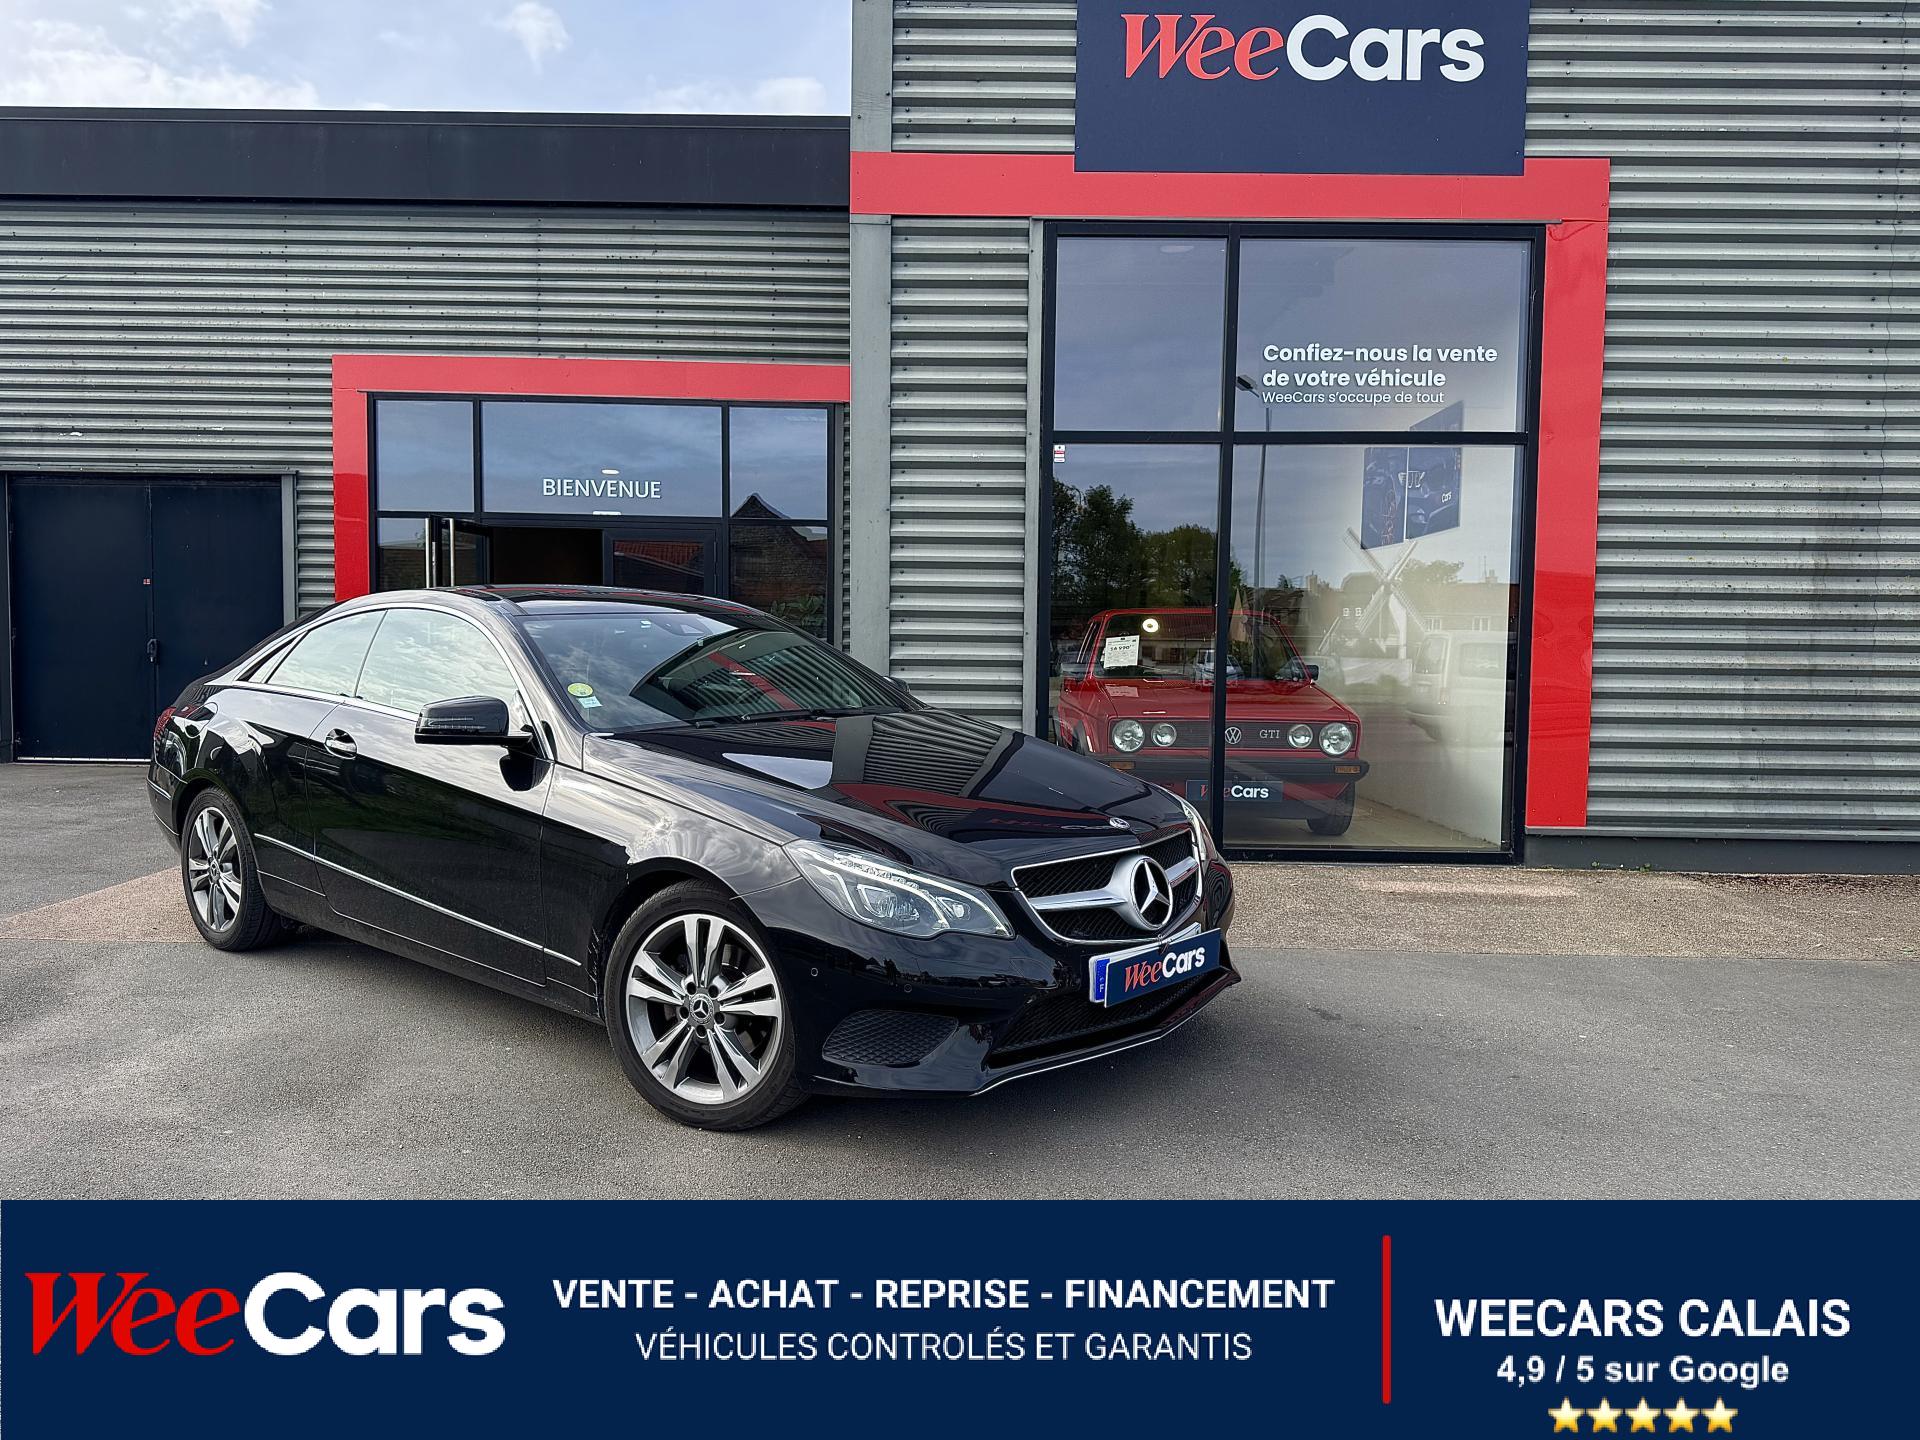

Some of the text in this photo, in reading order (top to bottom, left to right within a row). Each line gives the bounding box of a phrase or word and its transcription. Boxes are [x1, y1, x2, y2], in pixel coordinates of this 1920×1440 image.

[1120, 13, 1485, 82] WeeCars
[1263, 343, 1498, 363] Confiez-nous la vente
[1262, 367, 1446, 387] de votre véhicule
[1262, 391, 1325, 403] WeeCars
[1395, 391, 1414, 403] de
[1416, 391, 1445, 403] tout
[541, 477, 662, 499] BIENVENUE
[1259, 729, 1280, 739] GTI
[1124, 946, 1205, 993] WeeCars
